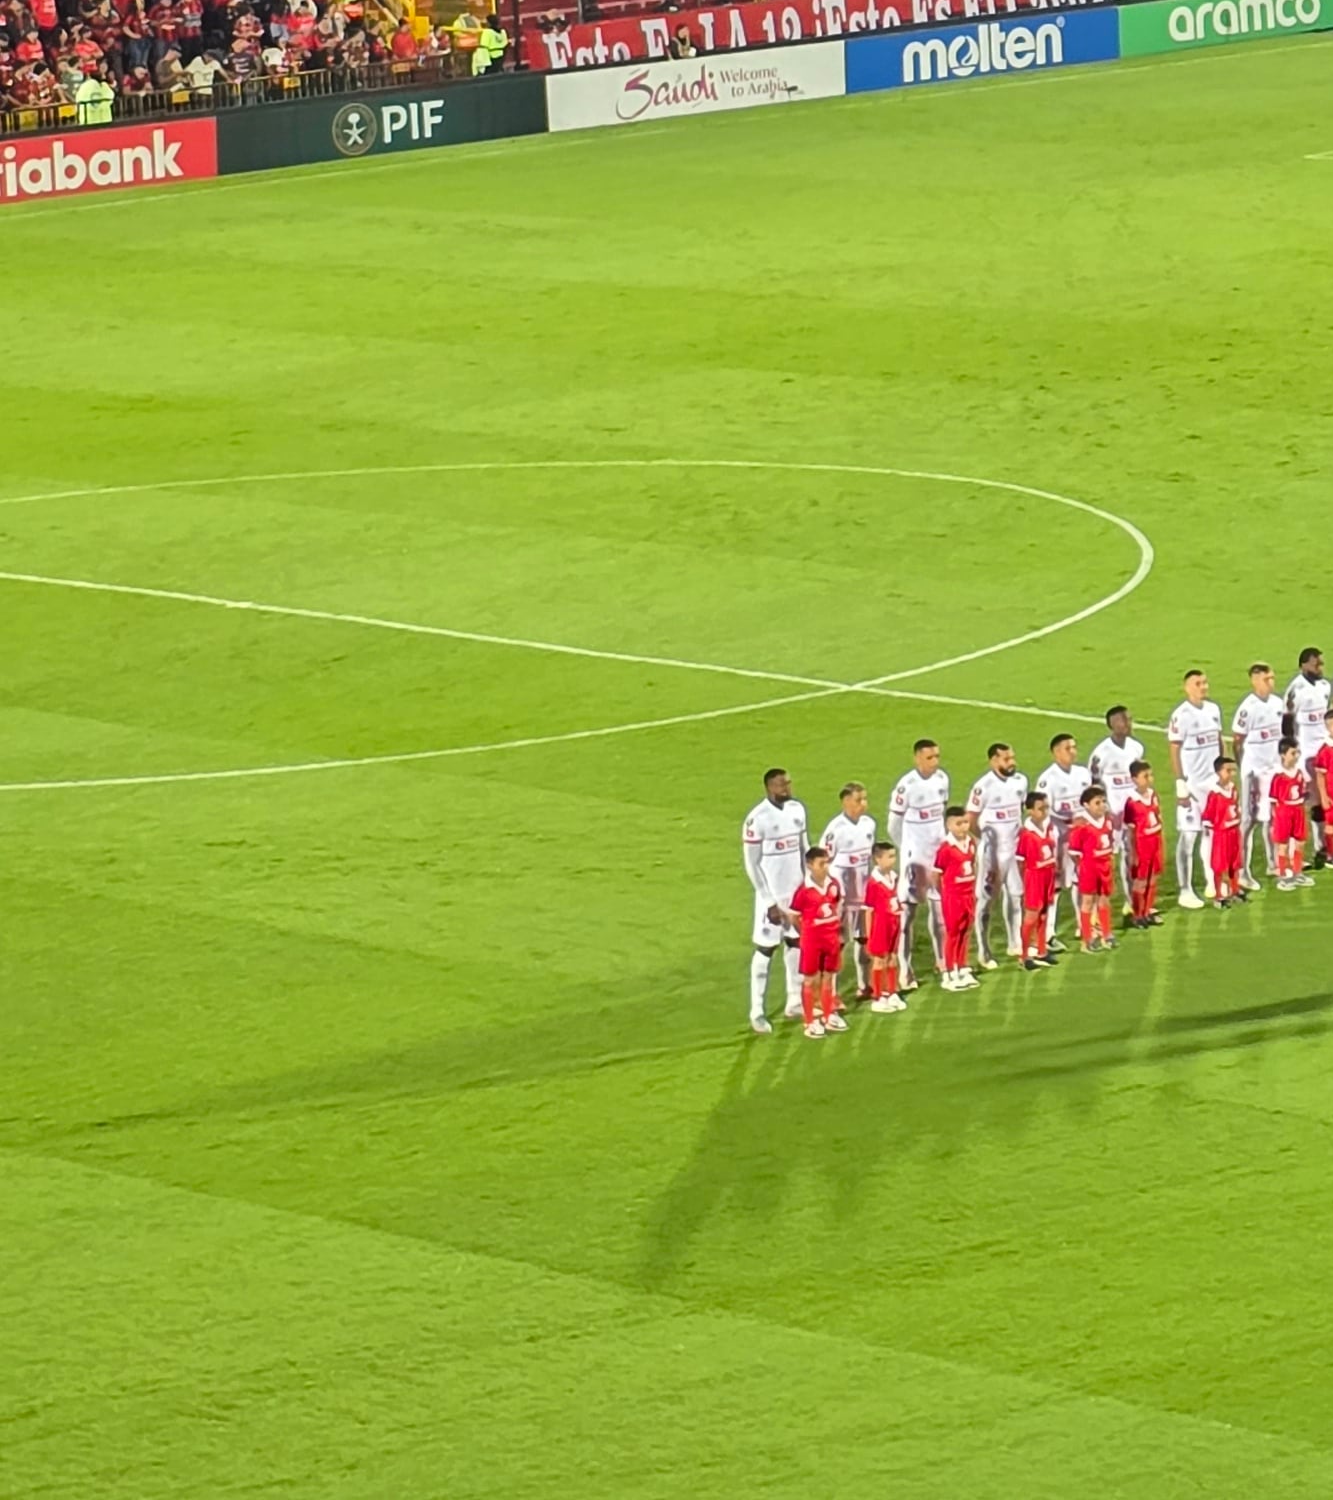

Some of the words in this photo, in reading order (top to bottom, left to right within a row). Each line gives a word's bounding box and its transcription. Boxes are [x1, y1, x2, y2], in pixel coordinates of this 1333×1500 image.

[902, 22, 1064, 83] molten
[616, 64, 719, 121] Saudi
[719, 67, 778, 84] Welcome
[731, 85, 744, 98] to
[381, 100, 444, 143] PIF
